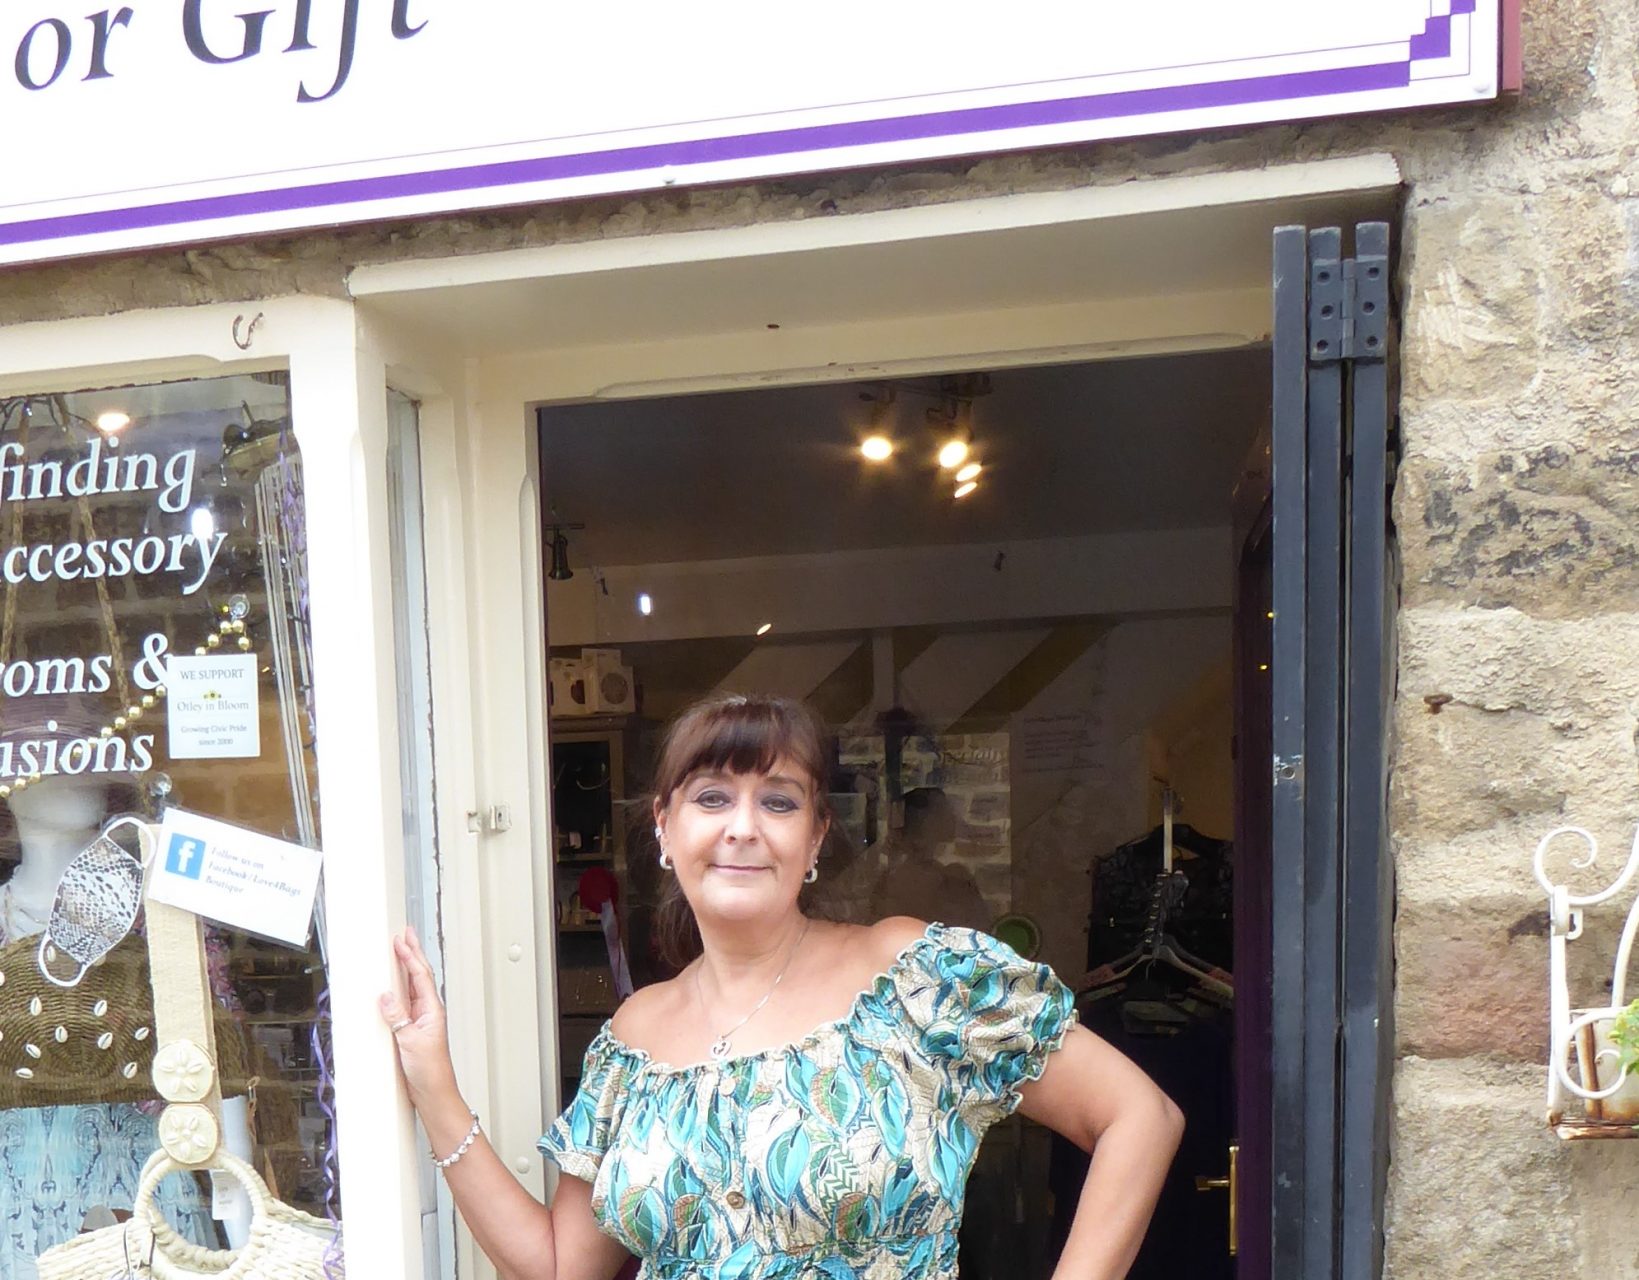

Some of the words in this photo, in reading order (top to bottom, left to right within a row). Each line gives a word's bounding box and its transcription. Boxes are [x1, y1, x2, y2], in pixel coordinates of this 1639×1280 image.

[15, 6, 134, 91] or
[0, 437, 196, 513] finding
[0, 533, 228, 595] ccessory
[0, 655, 112, 697] oms
[133, 633, 170, 690] &
[180, 670, 196, 680] WE
[198, 668, 244, 679] SUPPORT
[177, 701, 203, 713] Otley
[206, 702, 215, 711] in
[218, 700, 249, 710] Bloom
[181, 725, 209, 734] Growing
[211, 724, 227, 733] Civic
[229, 724, 247, 732] Pride
[211, 846, 238, 861] Follow
[241, 857, 251, 866] us
[206, 875, 243, 893] Boutique
